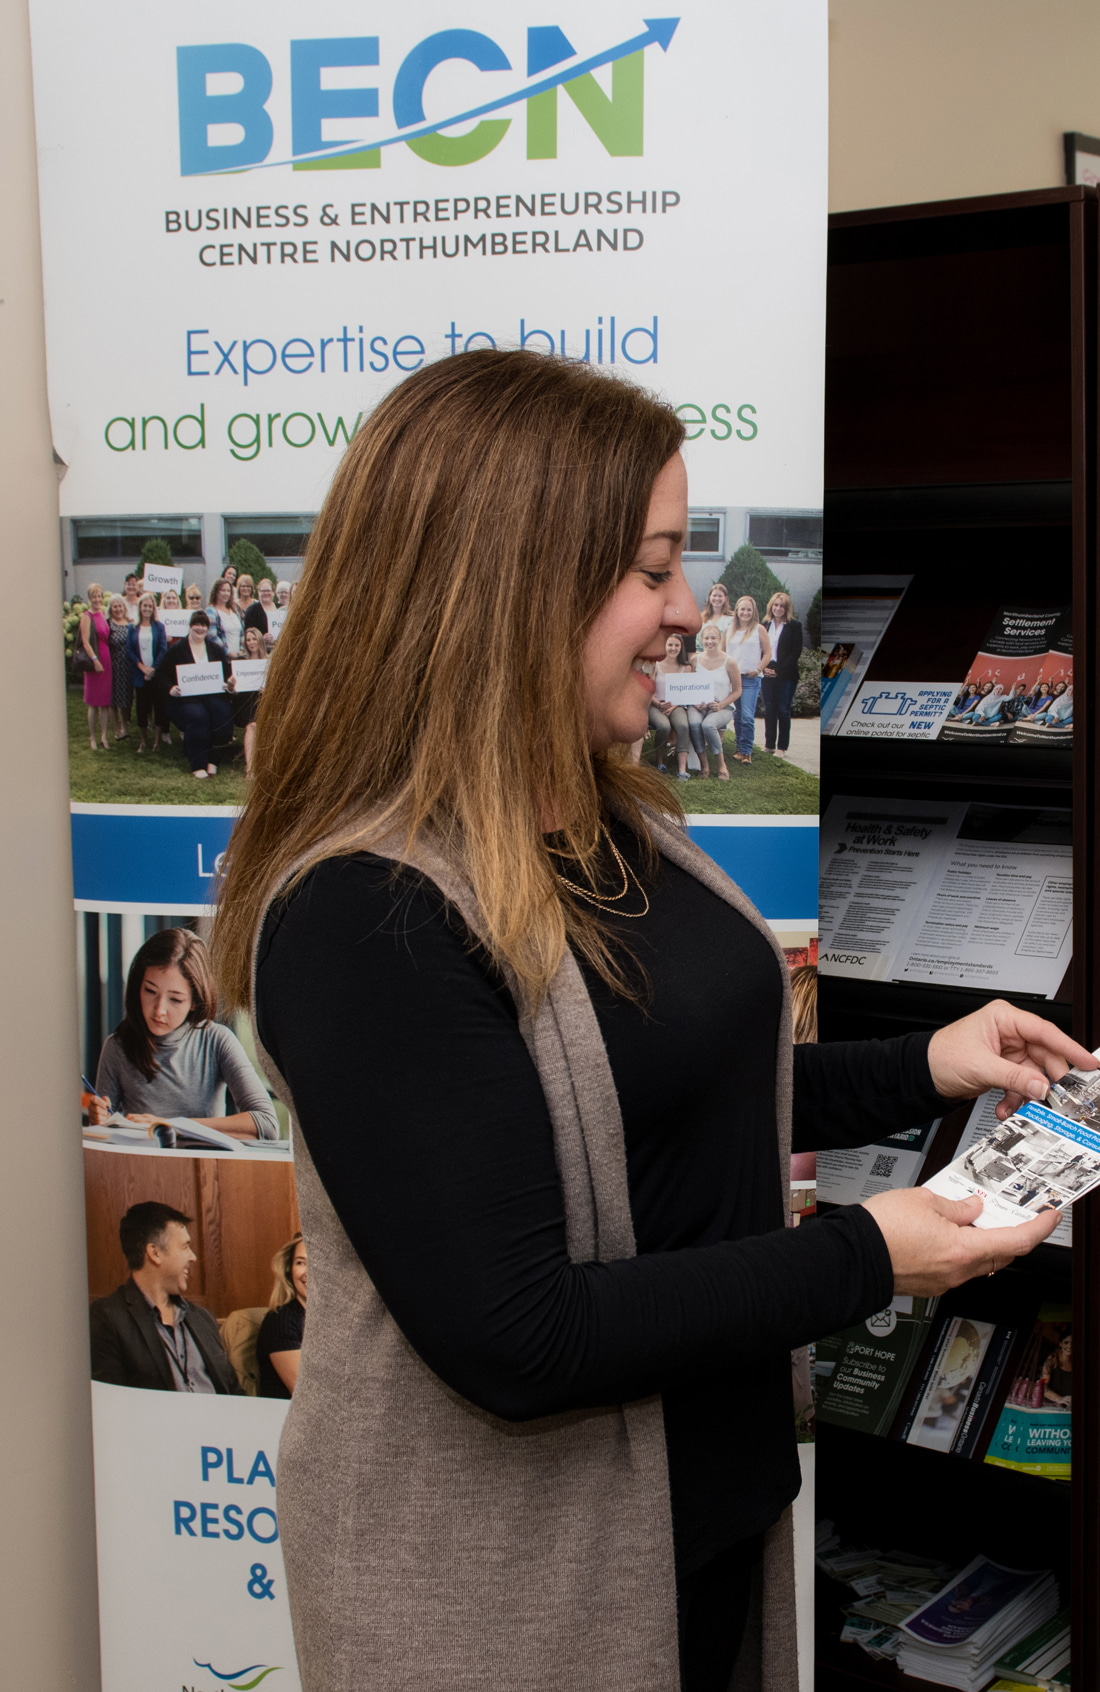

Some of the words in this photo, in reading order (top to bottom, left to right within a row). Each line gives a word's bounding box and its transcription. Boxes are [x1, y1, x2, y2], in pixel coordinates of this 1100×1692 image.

[176, 25, 646, 177] BECN
[164, 204, 310, 233] BUSINESS
[319, 203, 341, 227] &
[350, 190, 681, 226] ENTREPRENEURSHIP
[198, 240, 319, 268] CENTRE
[329, 228, 645, 263] NORTHUMBERLAND
[186, 325, 425, 387] Expertise
[520, 315, 658, 365] build
[104, 403, 206, 452] and
[227, 411, 363, 461] grow
[674, 403, 758, 441] ess
[147, 573, 179, 586] Growth
[164, 618, 190, 626] Creati
[1002, 617, 1056, 628] Settlement
[1003, 627, 1046, 636] Services
[181, 672, 220, 684] Confidence
[669, 682, 710, 693] Inspirational
[851, 720, 875, 728] Check
[876, 721, 891, 729] out
[908, 720, 935, 730] NEW
[870, 729, 895, 738] portal
[845, 822, 880, 834] Health
[882, 824, 893, 835] &
[894, 825, 932, 840] Safety
[852, 835, 864, 845] at
[866, 835, 899, 847] Work
[847, 846, 884, 855] Prevention
[883, 848, 904, 857] Starts
[197, 843, 231, 878] Le
[1025, 1111, 1054, 1130] Packaging,
[1053, 1124, 1077, 1140] Storage,
[1046, 1112, 1078, 1132] Small-Batch
[1076, 1127, 1091, 1138] Food
[854, 1345, 874, 1356] PORT
[874, 1349, 896, 1362] HOPE
[842, 1356, 877, 1371] Subscribe
[877, 1365, 887, 1373] to
[836, 1373, 880, 1390] Community
[840, 1366, 852, 1374] our
[852, 1367, 886, 1382] Business
[833, 1380, 865, 1394] Updates
[1028, 1428, 1072, 1439] WITHO
[1025, 1446, 1072, 1455] COMMUNI
[1026, 1438, 1062, 1447] LEAVING
[200, 1445, 276, 1487] PLA
[173, 1499, 279, 1544] RESO
[247, 1562, 275, 1601] &
